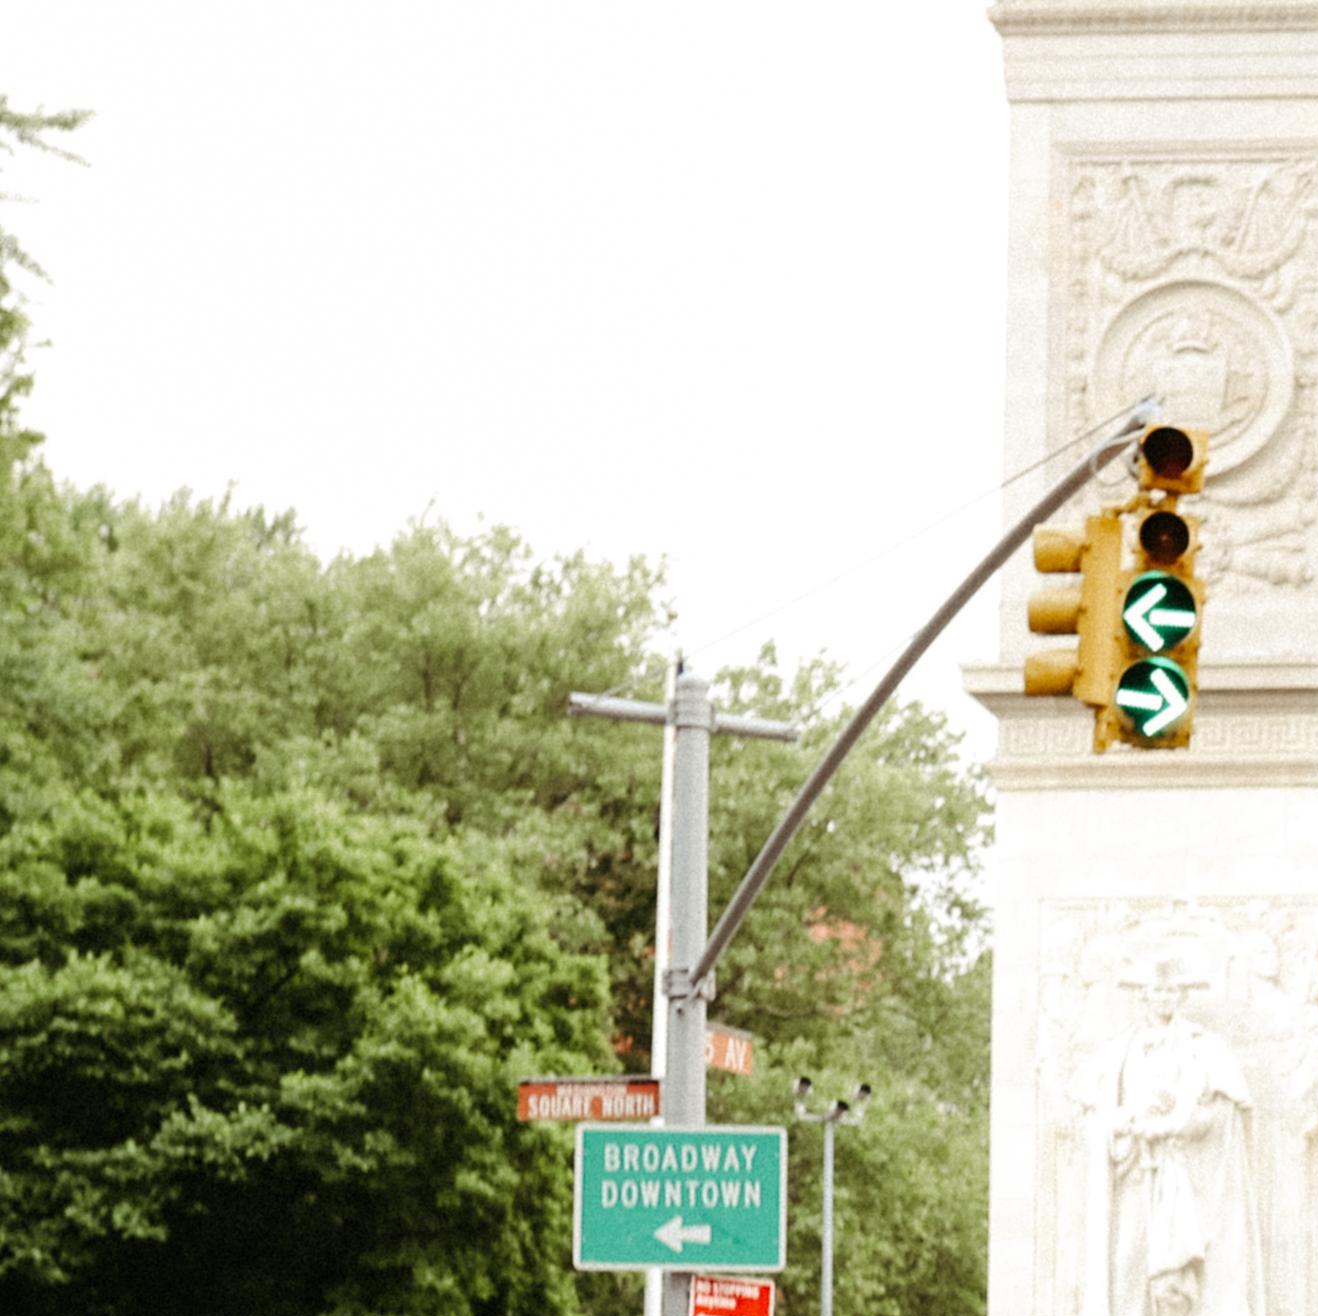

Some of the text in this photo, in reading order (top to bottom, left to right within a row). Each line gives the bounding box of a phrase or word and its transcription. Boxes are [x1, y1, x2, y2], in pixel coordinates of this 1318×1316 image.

[724, 1037, 748, 1071] AV
[527, 1092, 655, 1119] SQUARE NORTH
[604, 1144, 757, 1172] BROADWAY
[601, 1180, 761, 1208] DOWNTOWN
